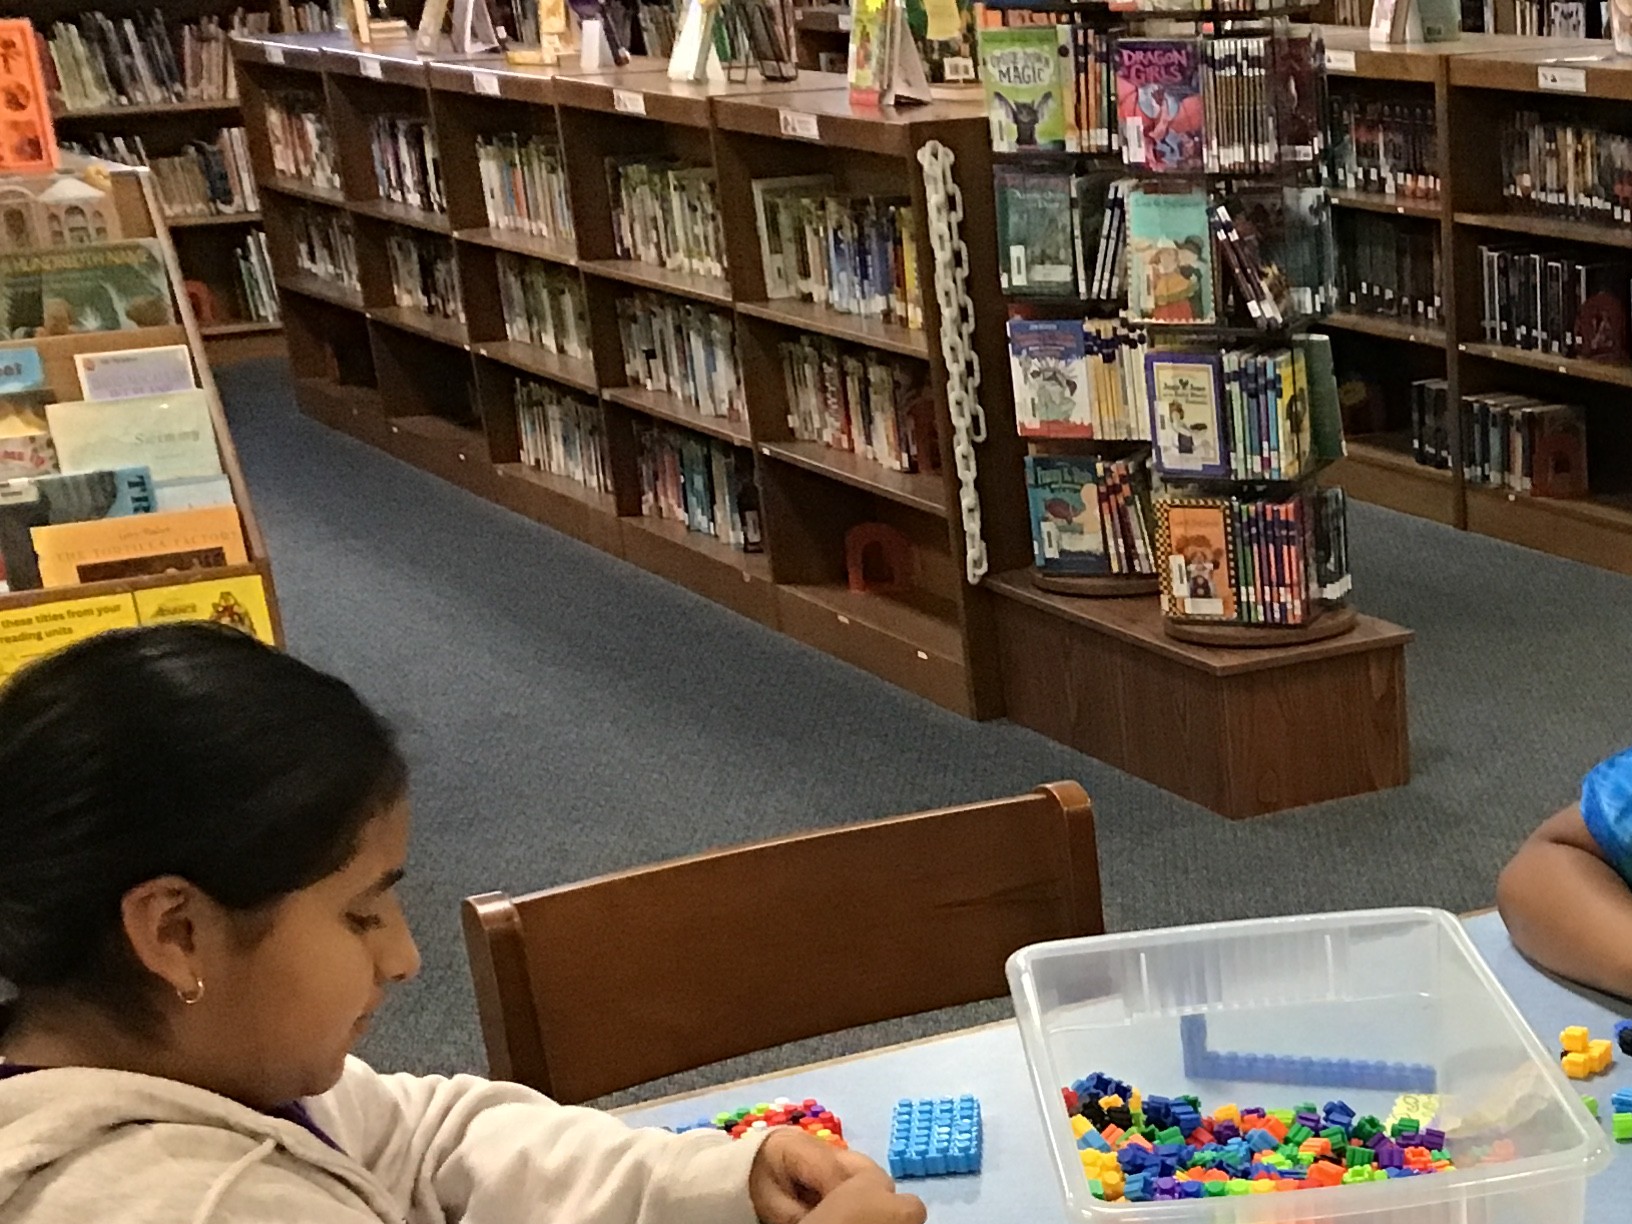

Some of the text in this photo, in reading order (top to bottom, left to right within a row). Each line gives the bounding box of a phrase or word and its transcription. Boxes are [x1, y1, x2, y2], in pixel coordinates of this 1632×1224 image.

[1122, 49, 1188, 66] DRAGON
[998, 65, 1045, 84] MAGIC
[1129, 65, 1182, 83] GIRLS
[35, 611, 65, 624] titles
[67, 607, 94, 619] from
[96, 603, 121, 618] your
[45, 626, 74, 639] units
